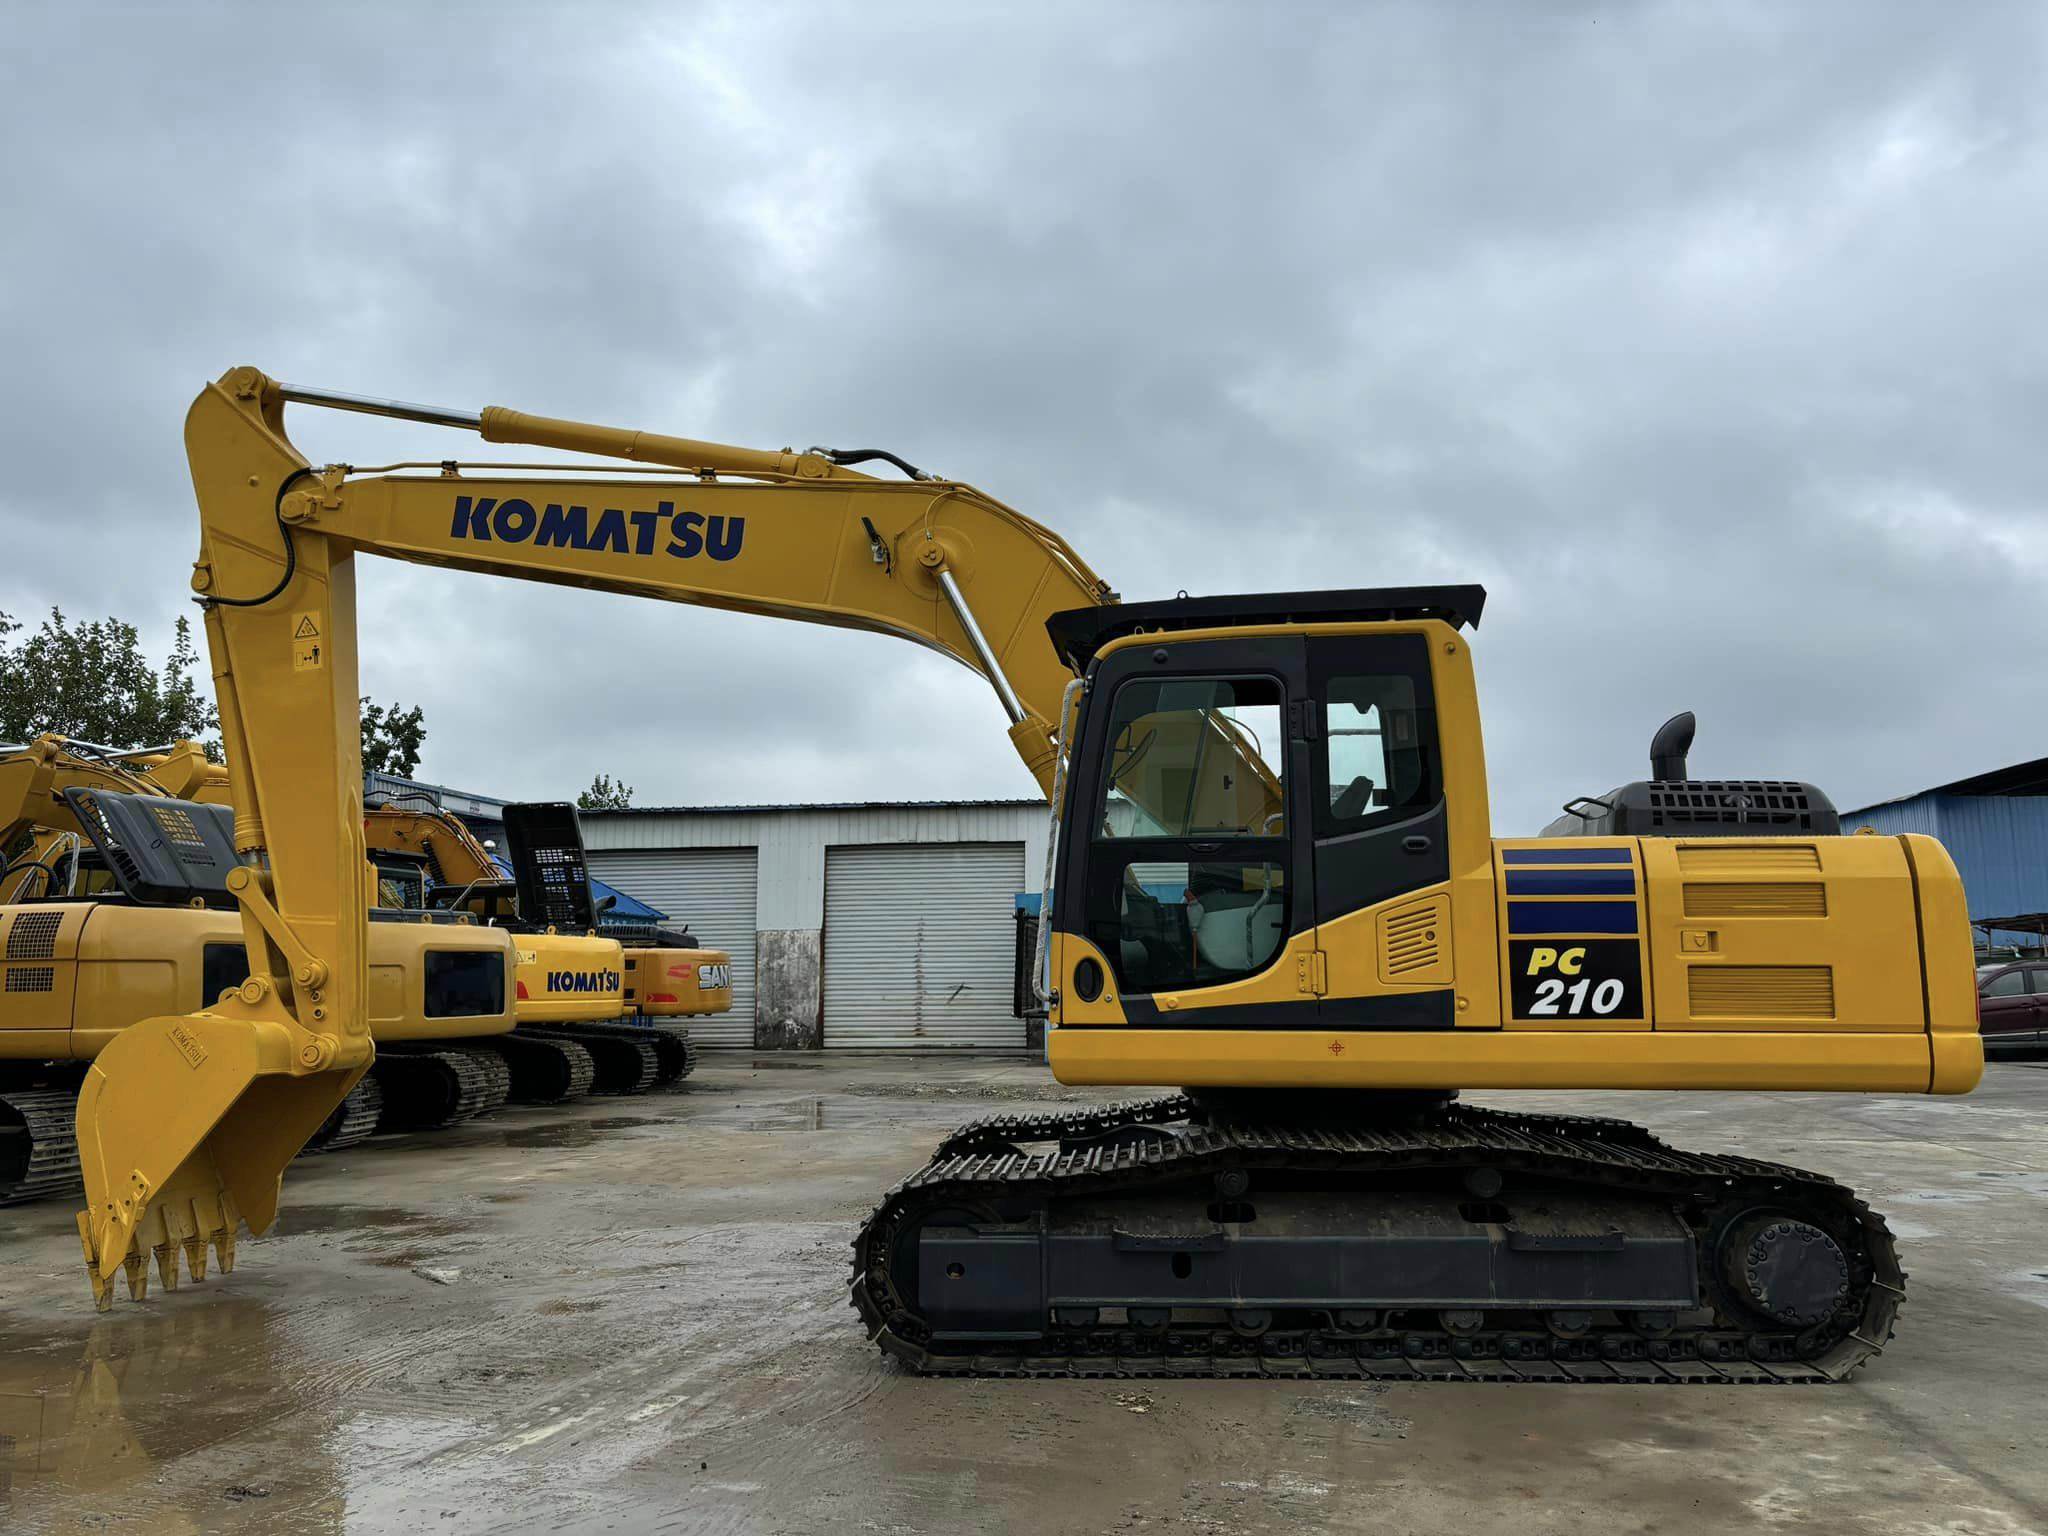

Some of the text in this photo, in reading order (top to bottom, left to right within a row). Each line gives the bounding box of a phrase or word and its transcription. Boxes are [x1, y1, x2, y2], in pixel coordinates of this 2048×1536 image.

[450, 496, 746, 561] KOMATSU
[698, 964, 732, 990] SAN
[1526, 947, 1586, 975] PC
[546, 967, 620, 992] KOMATSU
[1528, 978, 1624, 1014] 210
[172, 1026, 202, 1062] KOMATSU
